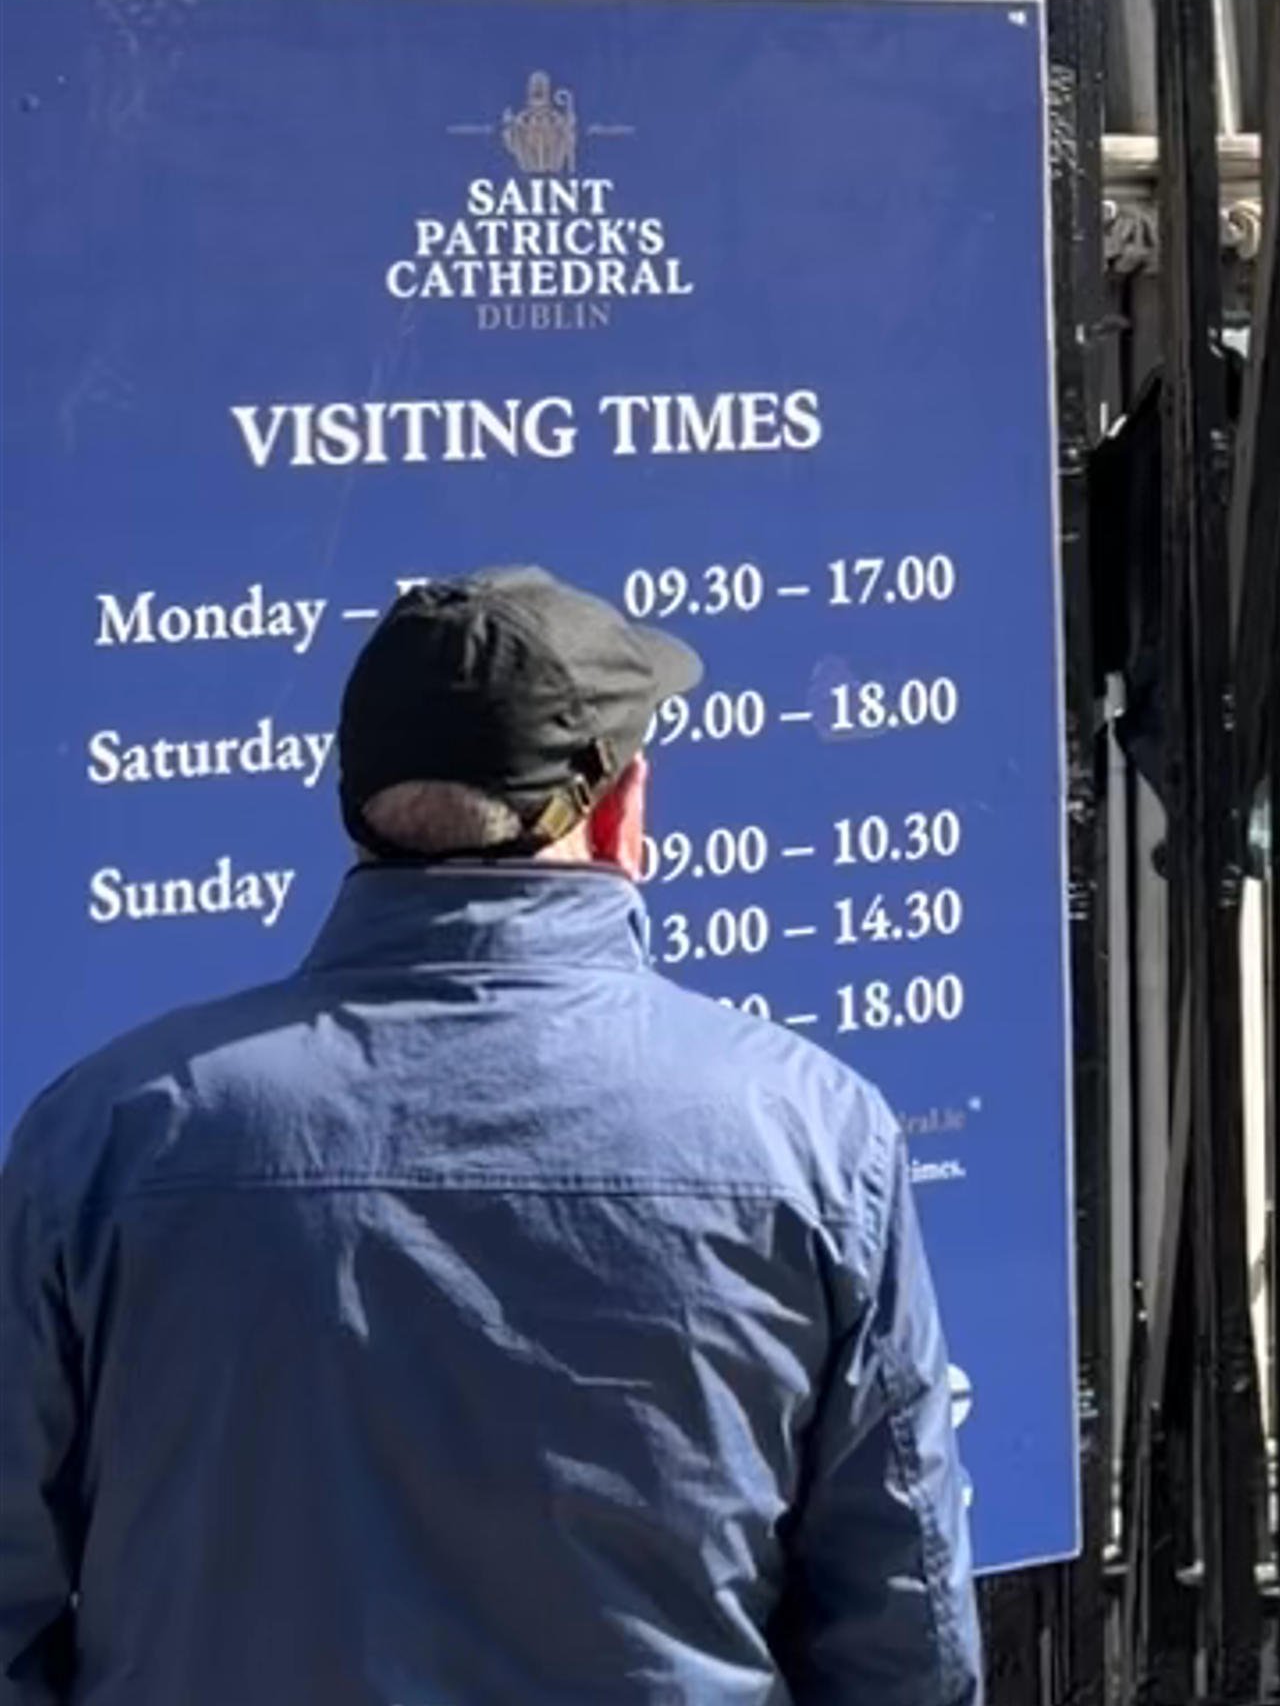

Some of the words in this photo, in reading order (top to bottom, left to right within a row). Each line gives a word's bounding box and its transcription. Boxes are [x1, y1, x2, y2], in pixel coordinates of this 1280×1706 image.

[468, 179, 613, 215] SAINT
[415, 218, 665, 256] PATRICK'S
[386, 259, 694, 298] CATHEDRAL
[477, 302, 611, 330] DUBLIN
[230, 397, 577, 466] VISITING
[600, 389, 822, 454] TIMES
[94, 583, 328, 654] Monday
[624, 563, 763, 618] 09.30
[828, 553, 956, 604] 17.00
[87, 717, 335, 787] Saturday
[830, 677, 957, 730] 18.00
[89, 855, 295, 927] Sunday
[834, 809, 960, 865] 10.30
[834, 887, 962, 945] 14.30
[837, 972, 964, 1033] 18.00
